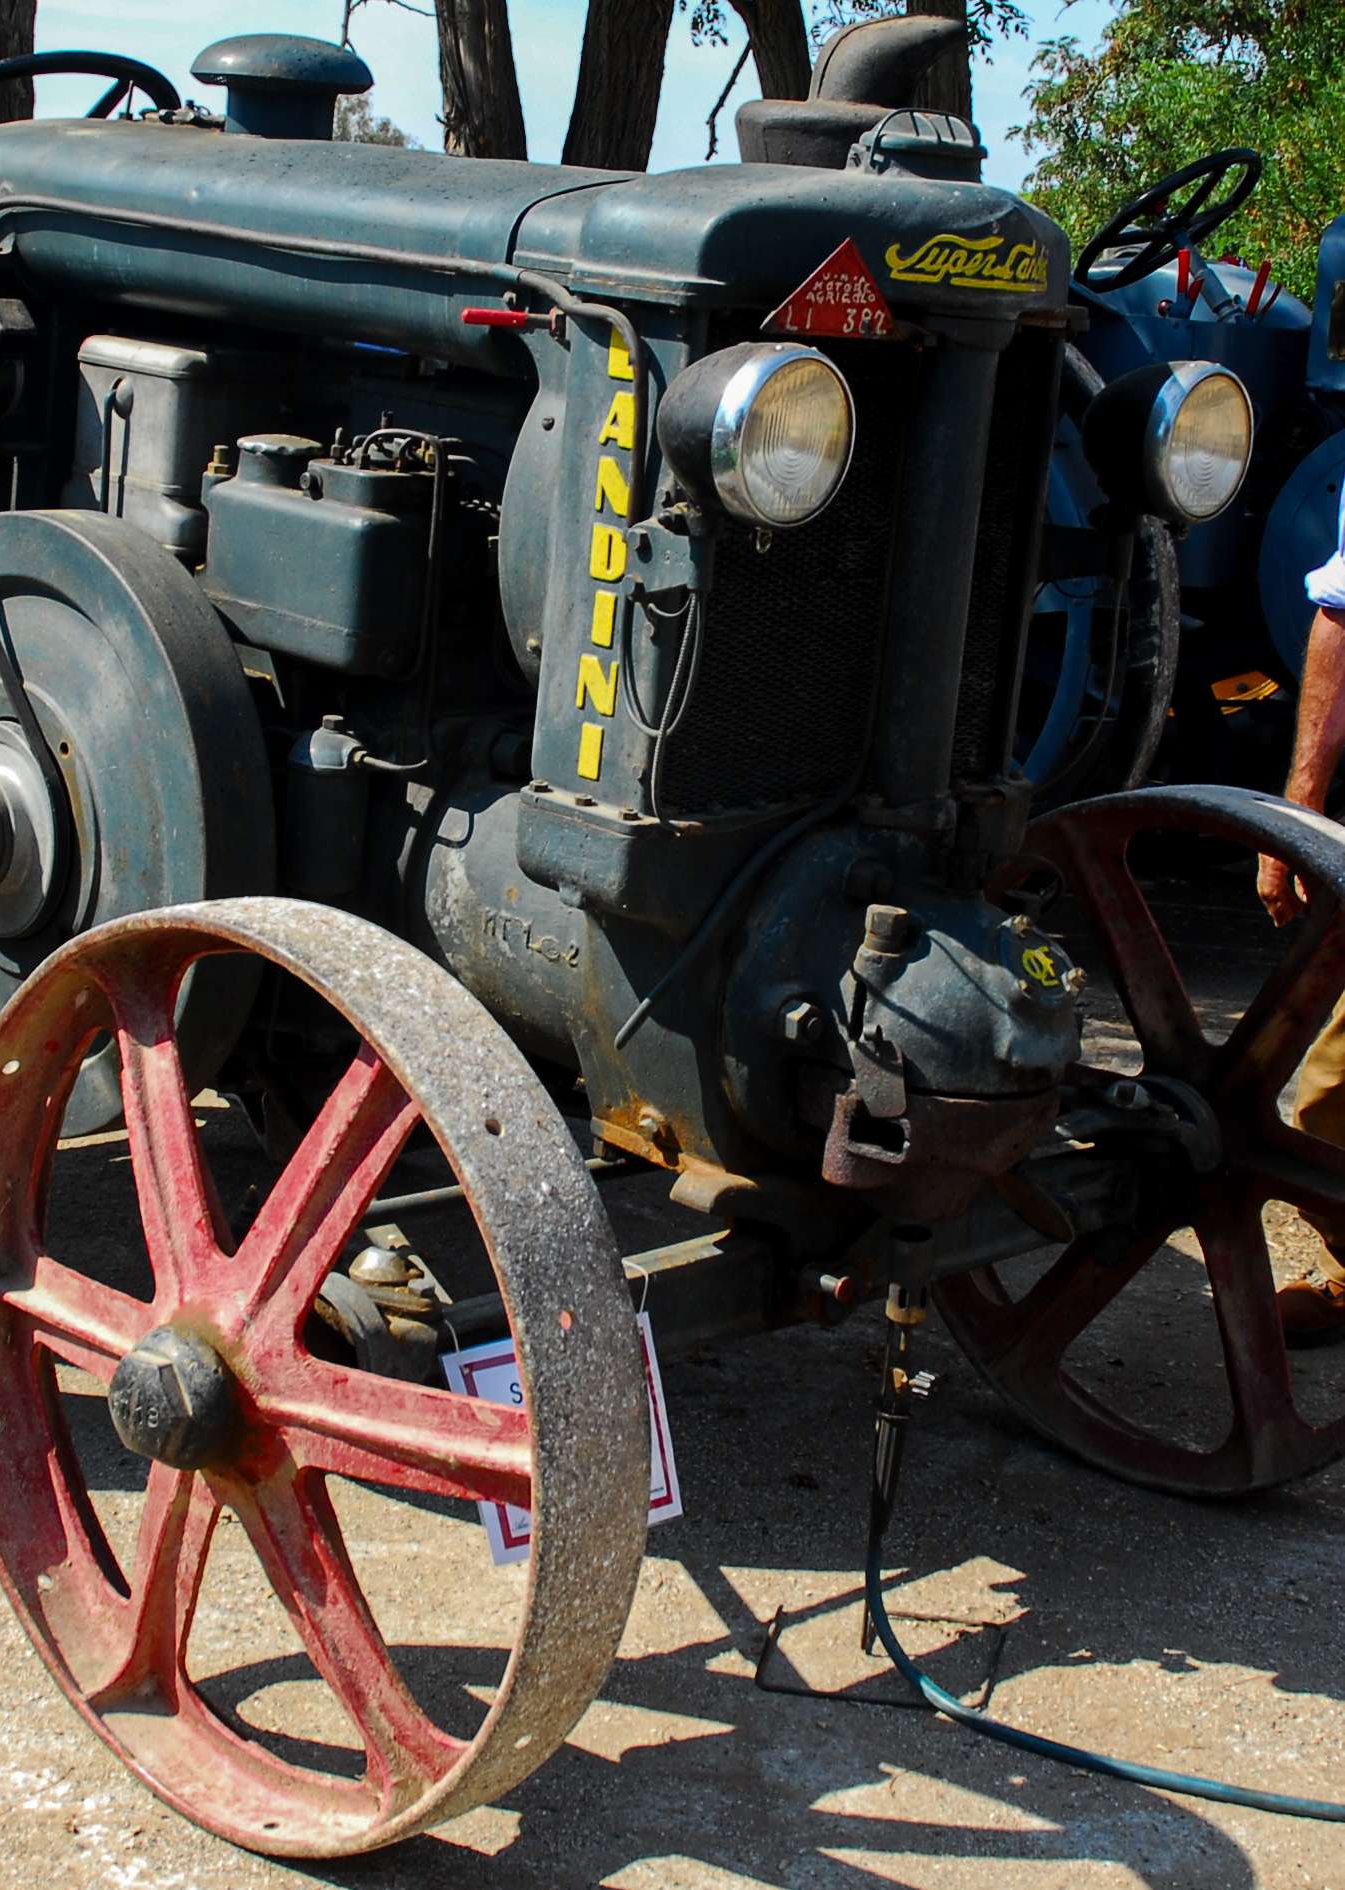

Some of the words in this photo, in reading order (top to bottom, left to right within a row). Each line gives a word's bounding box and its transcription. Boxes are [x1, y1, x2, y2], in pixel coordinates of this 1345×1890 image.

[805, 291, 876, 305] AGRICOLO
[842, 307, 887, 335] 382
[576, 325, 635, 781] LANDINI
